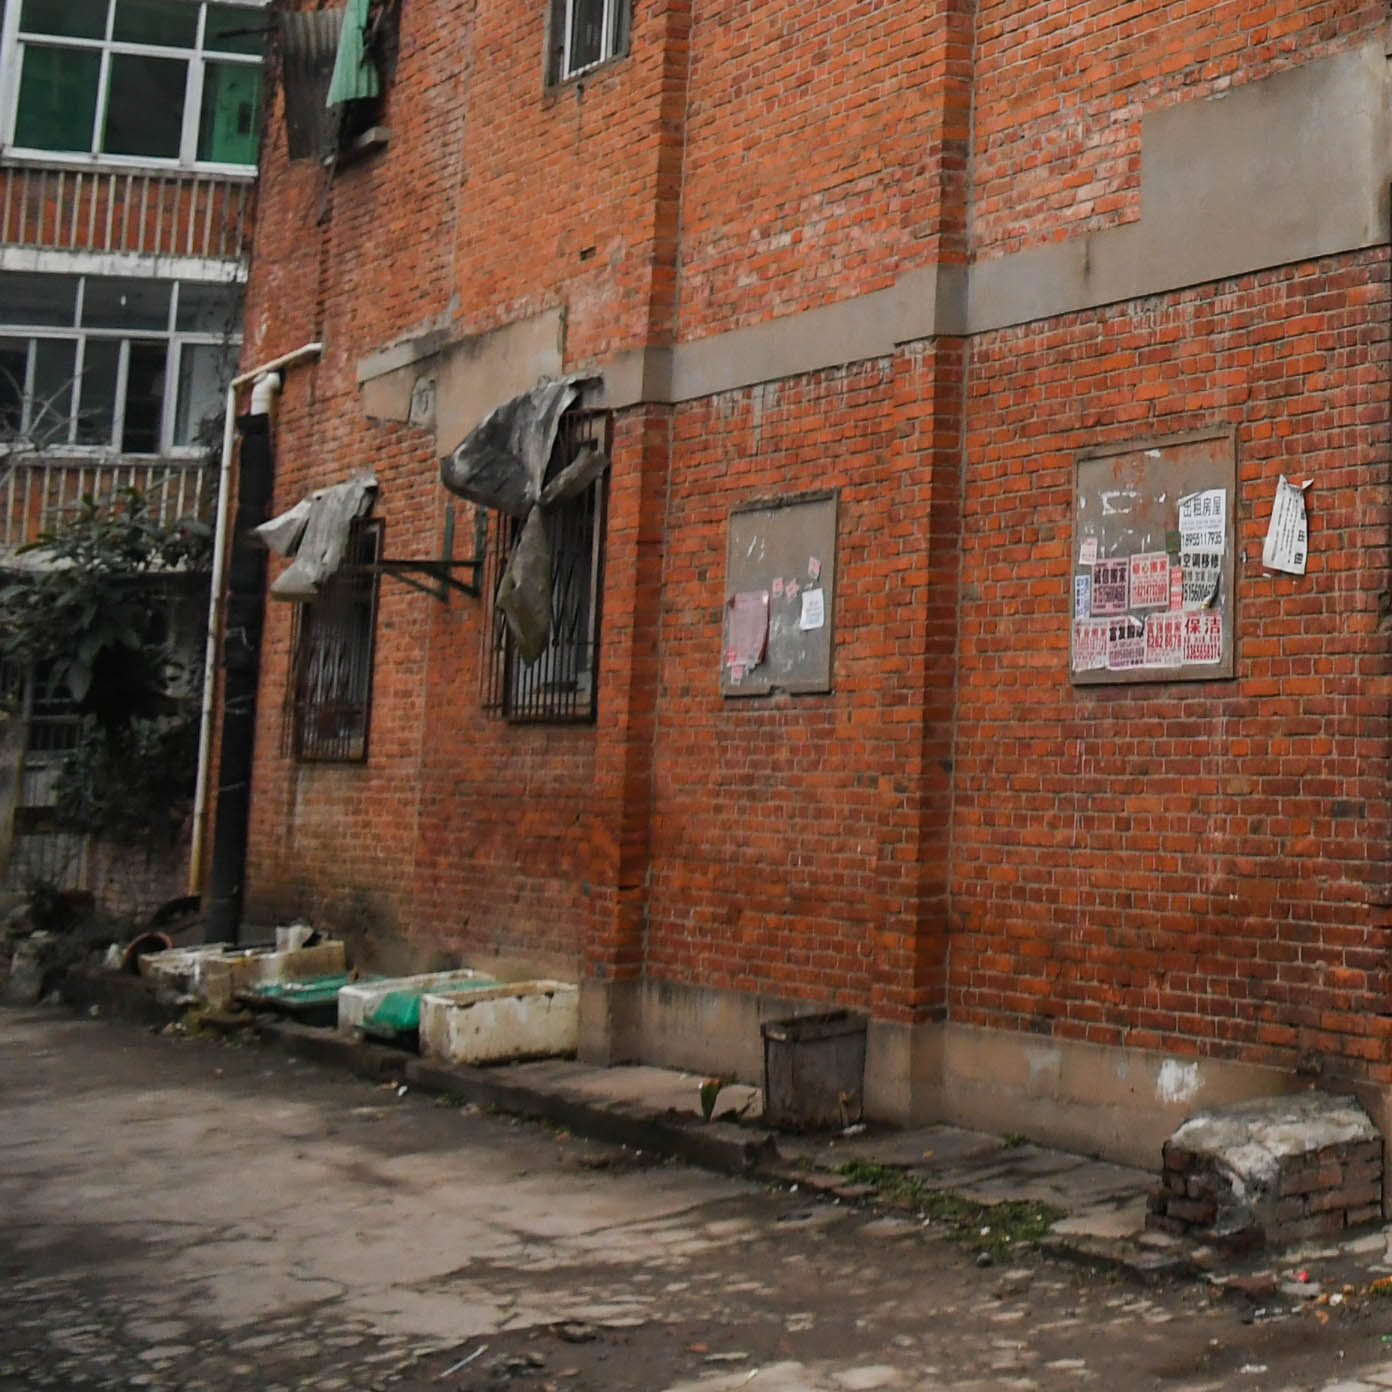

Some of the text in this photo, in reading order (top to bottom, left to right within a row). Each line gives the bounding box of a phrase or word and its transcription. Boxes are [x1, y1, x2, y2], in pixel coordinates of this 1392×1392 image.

[1183, 496, 1221, 517] 出租房屋
[1185, 615, 1220, 634] 保洁
